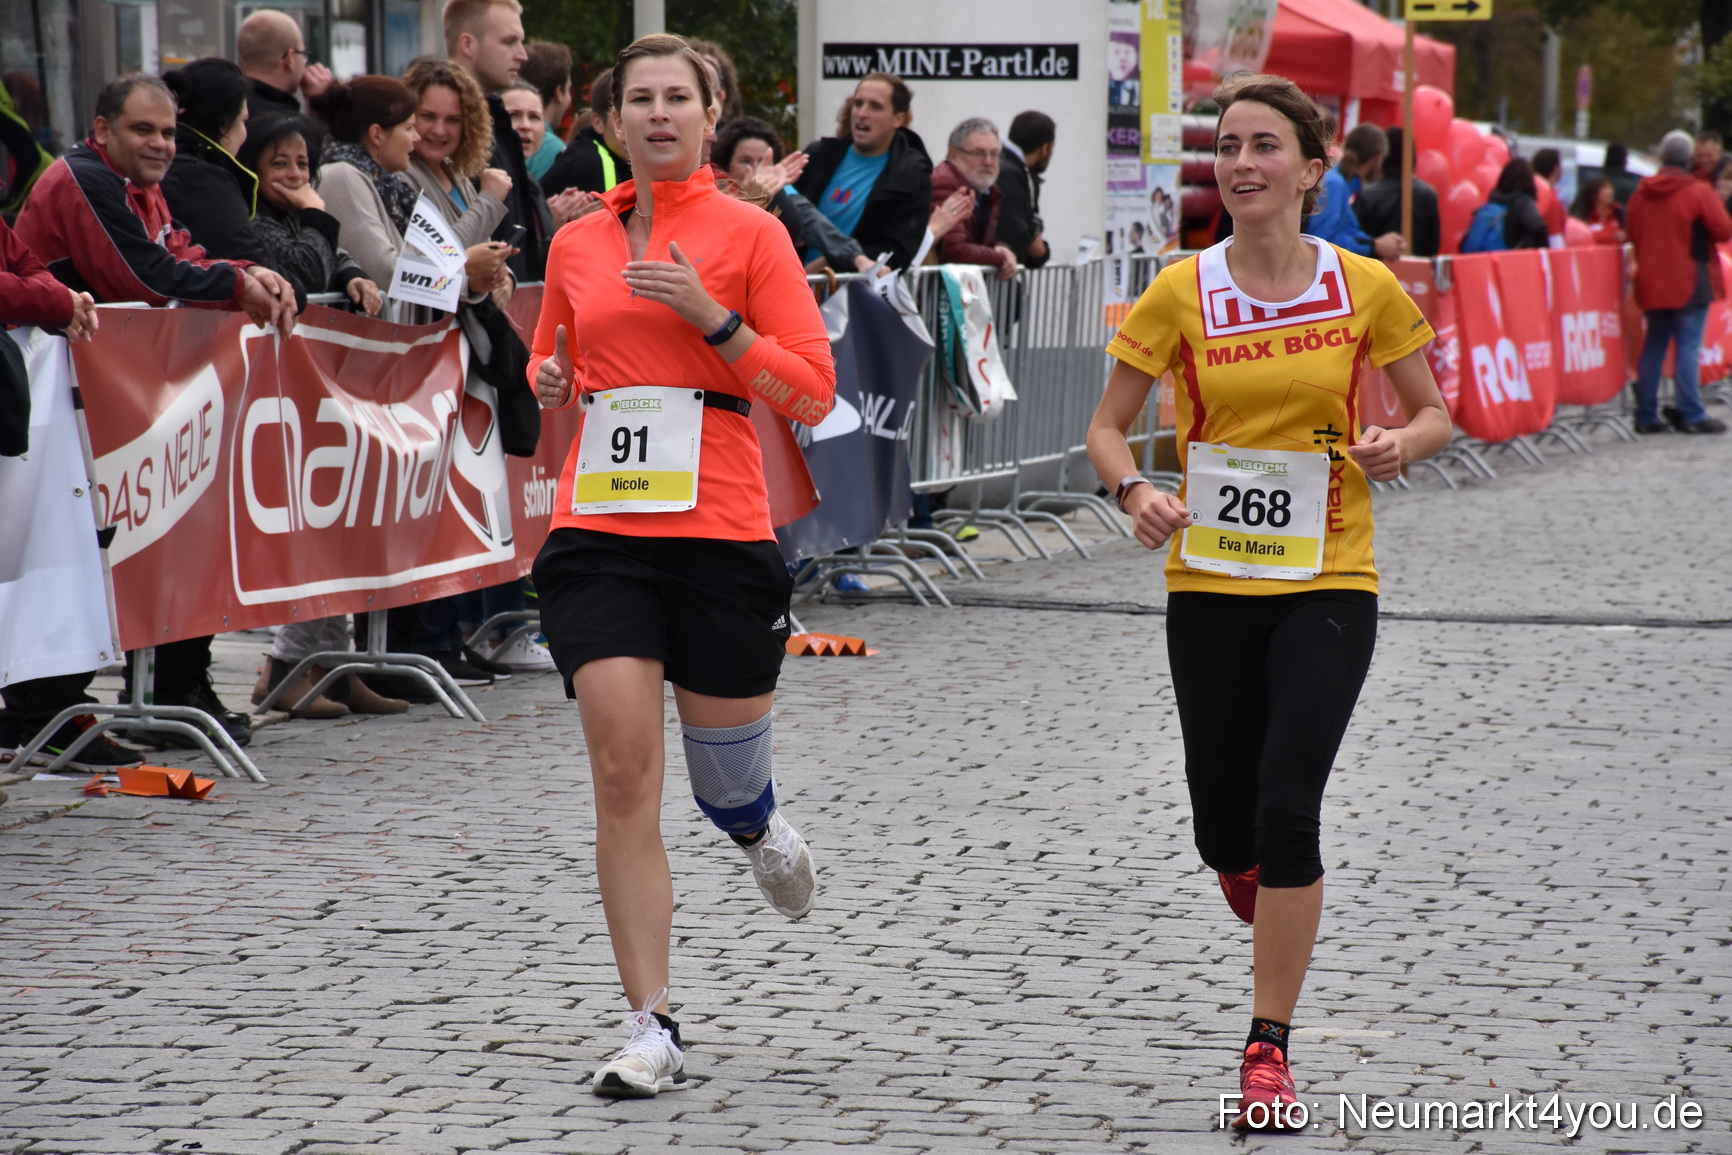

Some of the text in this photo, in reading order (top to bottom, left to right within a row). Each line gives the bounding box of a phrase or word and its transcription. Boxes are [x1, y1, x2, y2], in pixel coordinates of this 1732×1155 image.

[823, 47, 1070, 77] www.MINI-Partl.de
[411, 213, 445, 245] swn
[1206, 327, 1358, 367] MAX BÖGL
[749, 368, 794, 405] RUN
[620, 399, 662, 410] BOCK
[611, 426, 648, 463] 91
[98, 400, 212, 532] DAS NEUE
[1240, 460, 1288, 473] BOCK
[611, 477, 649, 491] Nicole
[1218, 485, 1291, 527] 268
[1219, 536, 1285, 556] Eva Maria
